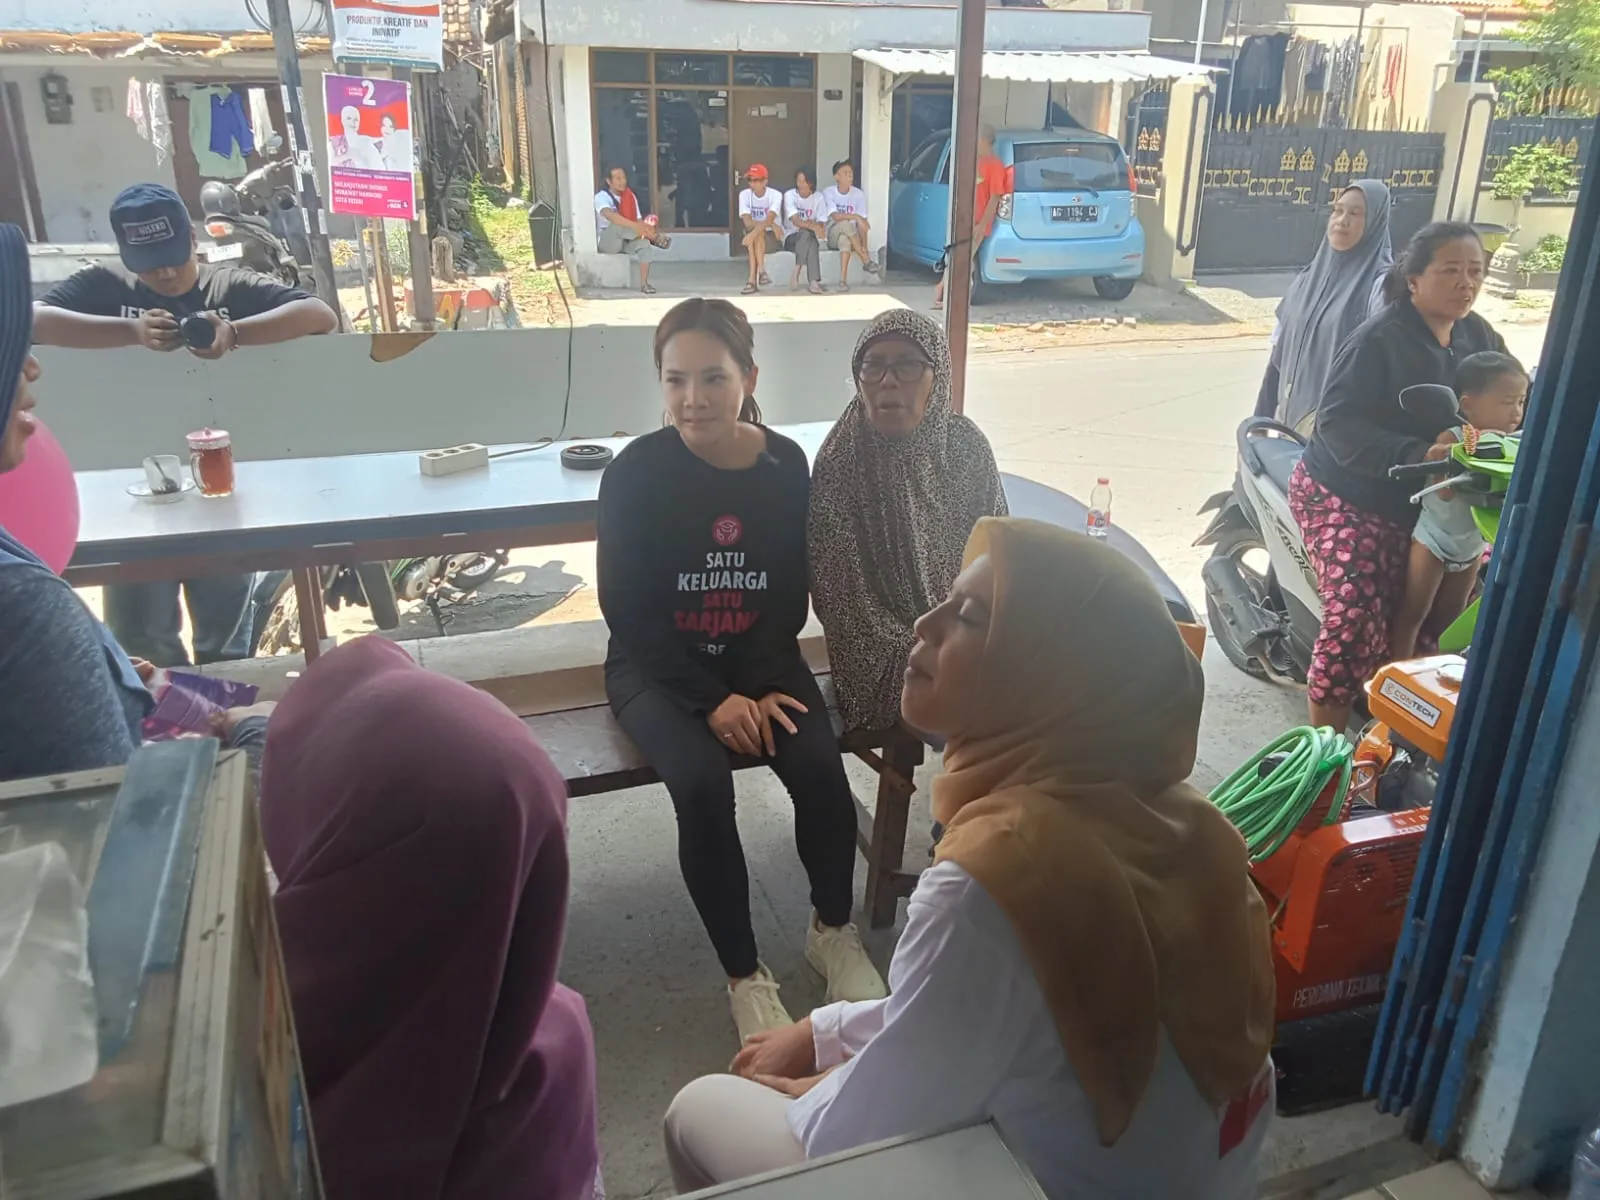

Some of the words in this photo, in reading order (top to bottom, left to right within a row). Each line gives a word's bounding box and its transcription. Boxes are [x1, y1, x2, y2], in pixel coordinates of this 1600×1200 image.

[383, 16, 412, 28] KREATIF
[413, 19, 429, 28] DAN
[372, 28, 401, 37] INOVATIF
[361, 80, 376, 106] 2
[706, 551, 745, 569] SATU
[677, 570, 768, 592] KELUARGA
[703, 591, 743, 608] SATU
[1393, 689, 1435, 721] CONTECH
